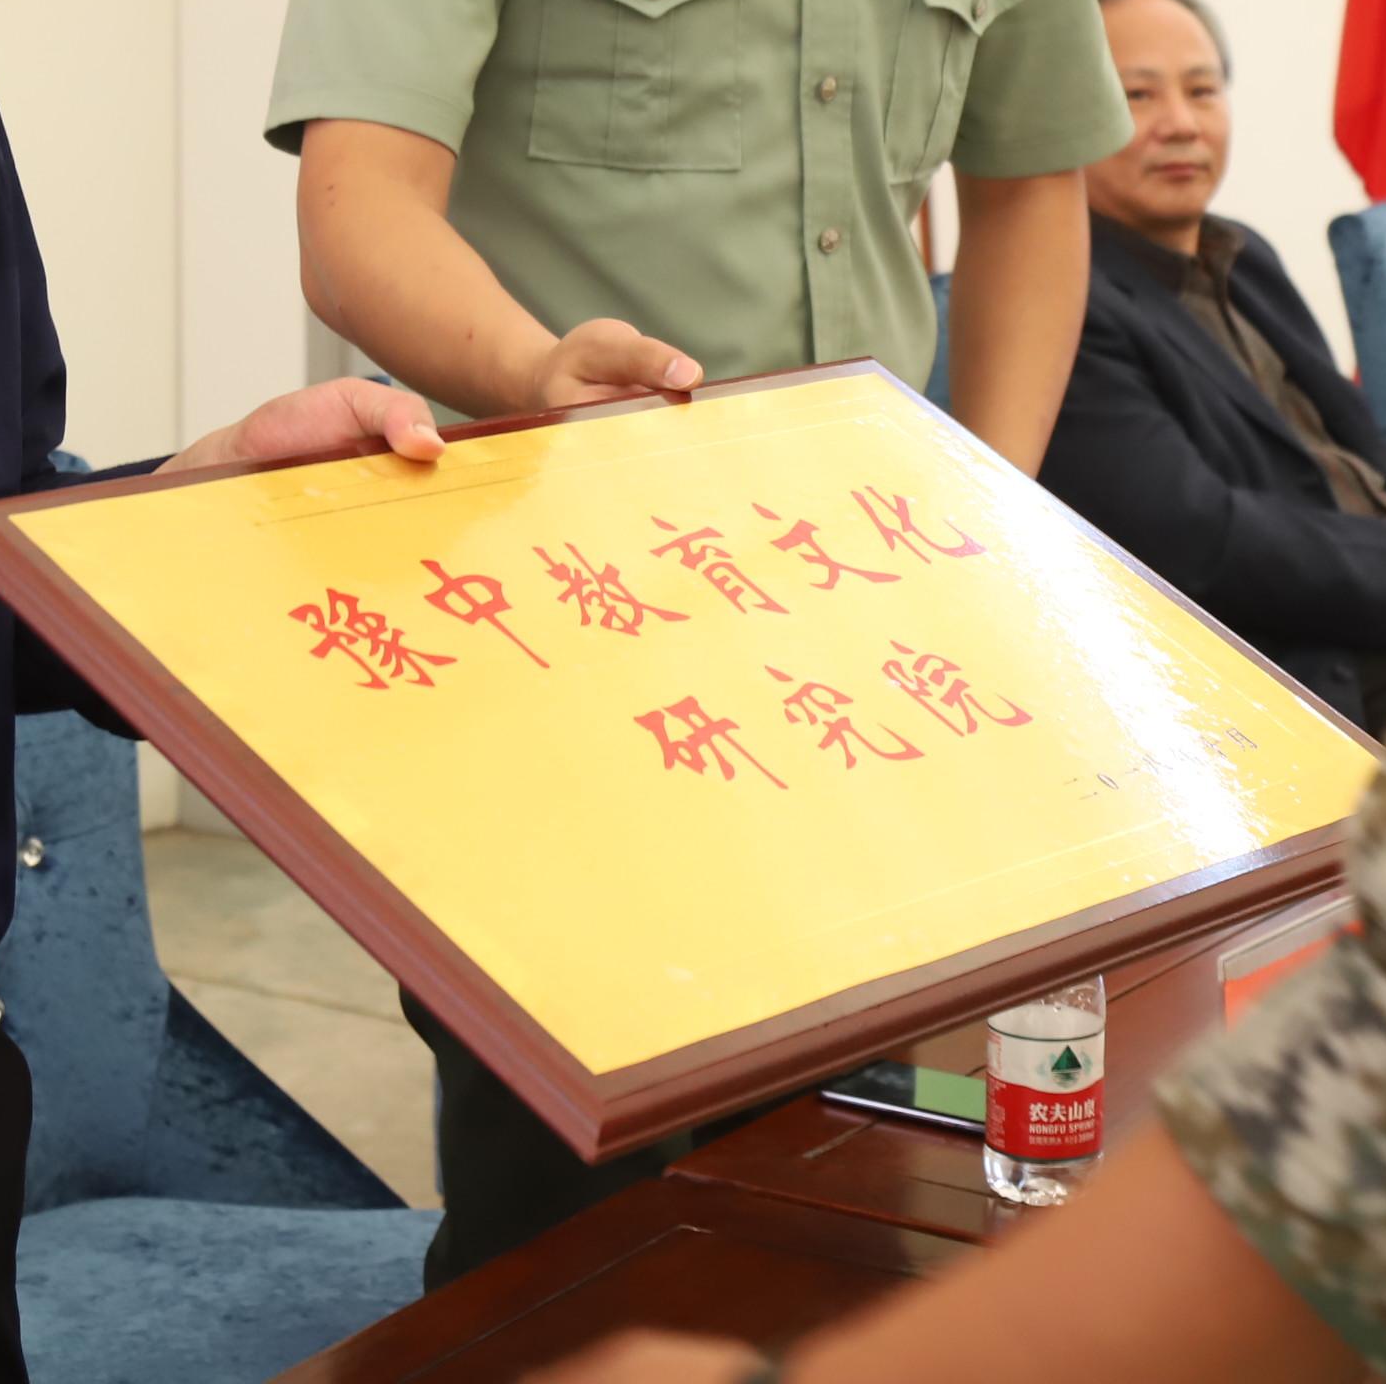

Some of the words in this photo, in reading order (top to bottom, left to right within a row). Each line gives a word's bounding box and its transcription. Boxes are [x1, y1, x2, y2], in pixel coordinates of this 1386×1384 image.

[287, 485, 987, 691] 豫中教育文化
[633, 640, 1034, 790] 研究院
[1029, 1099, 1095, 1122] 农夫山泉
[1029, 1123, 1066, 1134] NONGFU
